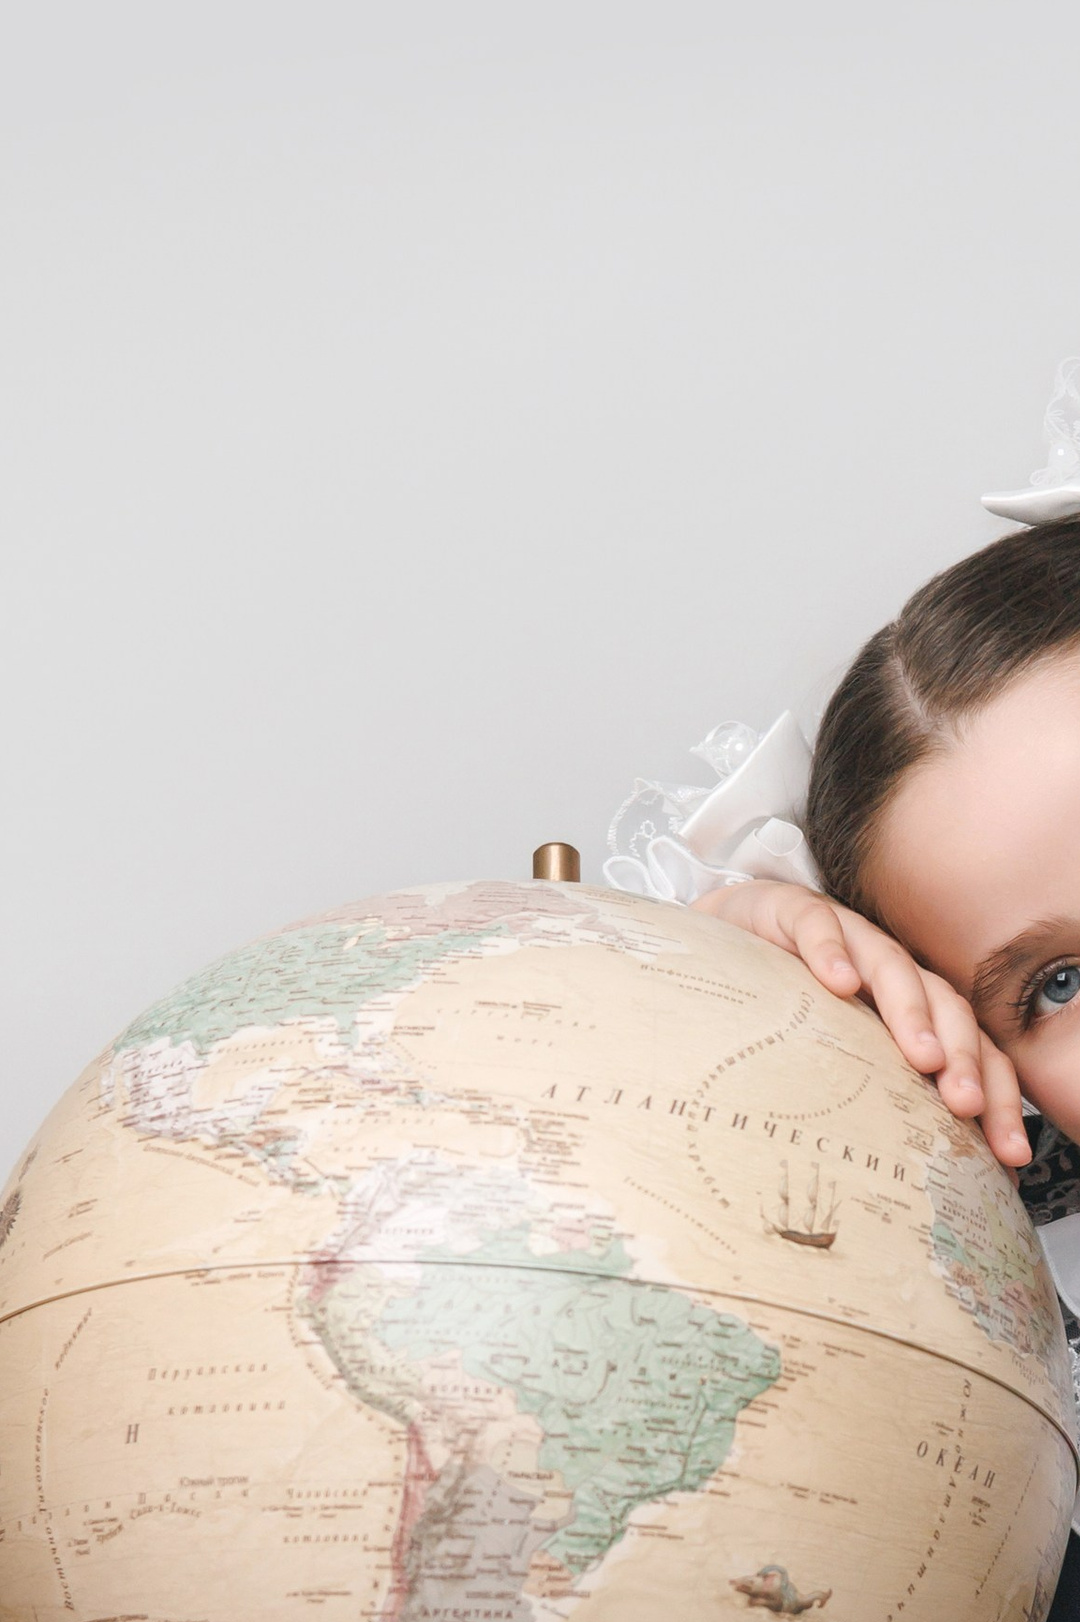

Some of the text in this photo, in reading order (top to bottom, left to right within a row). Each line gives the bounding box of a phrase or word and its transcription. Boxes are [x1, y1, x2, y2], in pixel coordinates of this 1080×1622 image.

[540, 1083, 907, 1182] АТЛАНТИЧЕСКИЙ
[916, 1440, 996, 1489] ОКЕАН
[422, 1608, 514, 1620] АРГЕНТИНА
